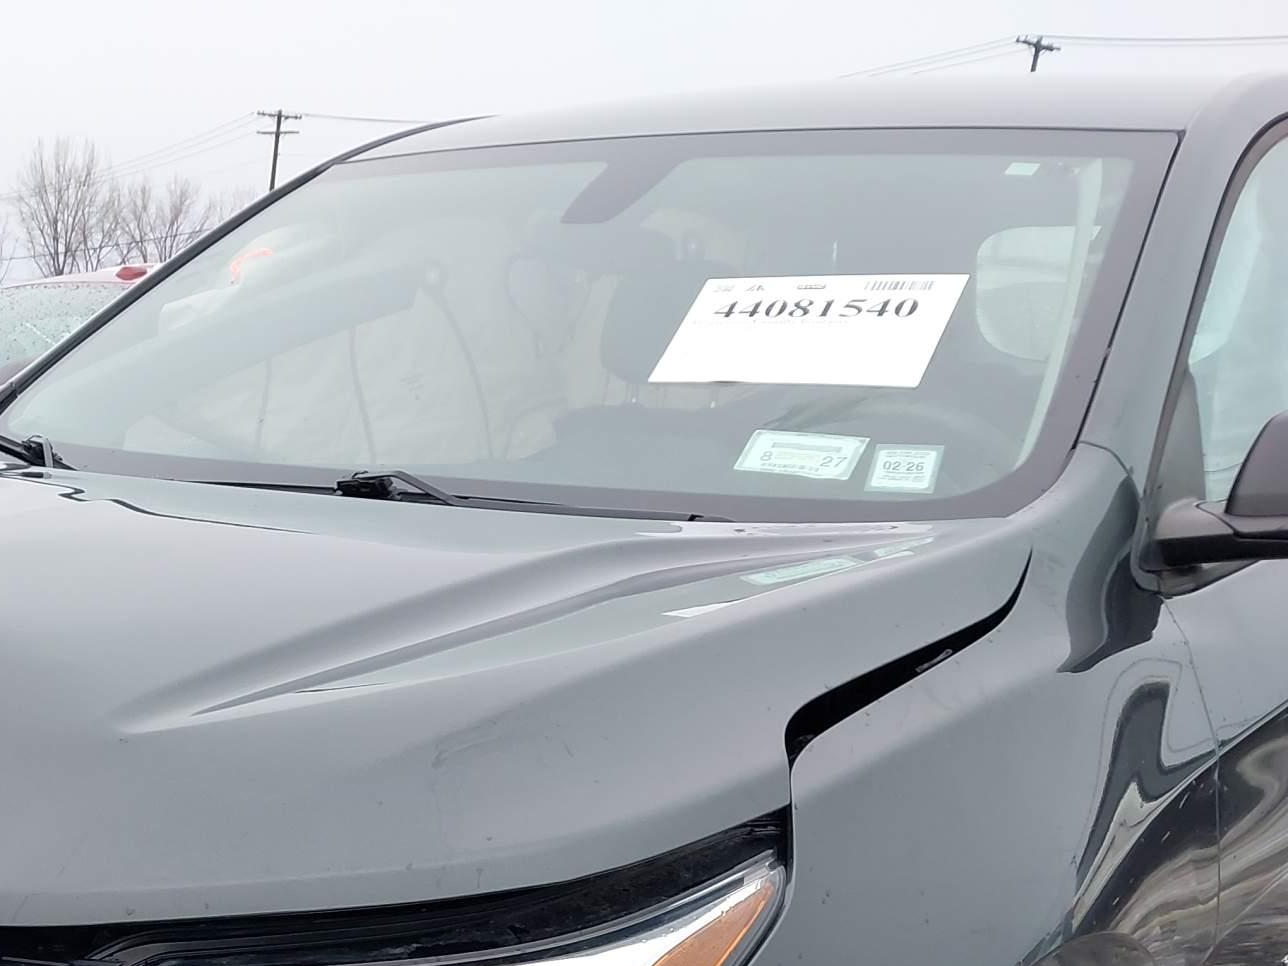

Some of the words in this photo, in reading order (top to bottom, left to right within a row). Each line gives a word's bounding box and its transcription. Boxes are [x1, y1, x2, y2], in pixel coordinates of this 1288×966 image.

[714, 297, 920, 319] 44081540
[759, 450, 773, 462] 8
[820, 455, 848, 468] 27
